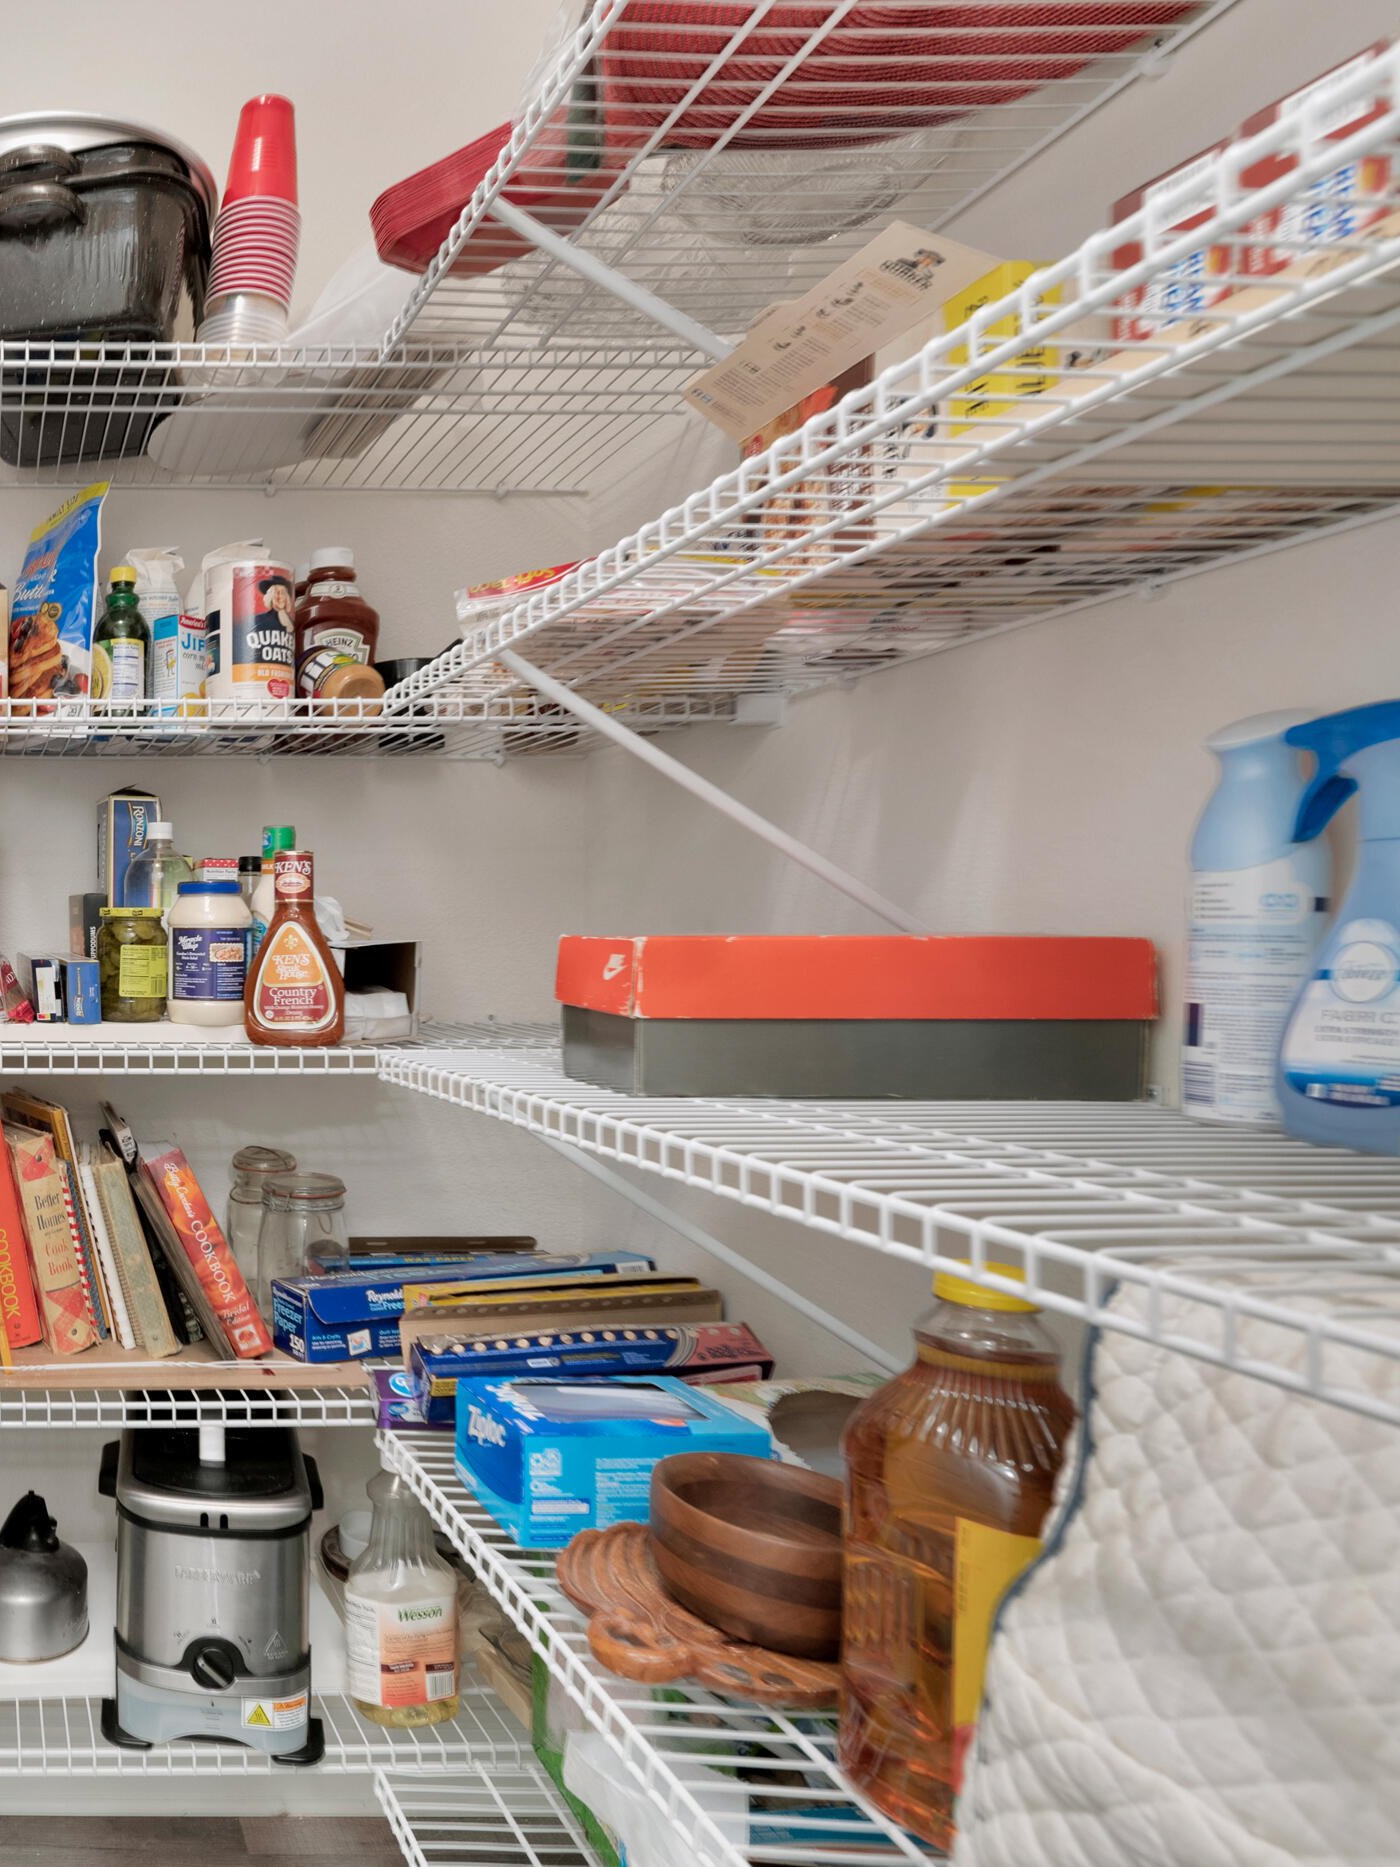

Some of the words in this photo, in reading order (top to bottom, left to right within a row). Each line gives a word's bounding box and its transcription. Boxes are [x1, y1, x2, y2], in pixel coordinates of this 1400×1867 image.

[327, 637, 354, 647] HEINZ
[261, 646, 294, 663] OATS
[132, 805, 145, 847] RONZONI
[274, 860, 312, 876] KEN'S
[271, 953, 311, 966] KEN'S
[269, 987, 317, 999] Country
[273, 995, 314, 1006] French
[34, 1192, 60, 1211] Better
[36, 1213, 66, 1231] Homes
[164, 1162, 180, 1187] Betty
[174, 1185, 194, 1219] Crocker's
[190, 1219, 237, 1303] COOKBOOK
[45, 1238, 70, 1257] Cook
[48, 1257, 74, 1276] Book
[221, 1301, 250, 1320] Bridal
[273, 1297, 304, 1325] Freezer
[273, 1311, 297, 1335] Paper
[288, 1333, 305, 1354] 150
[467, 1403, 507, 1448] Ziploc
[397, 1607, 443, 1623] Wesson
